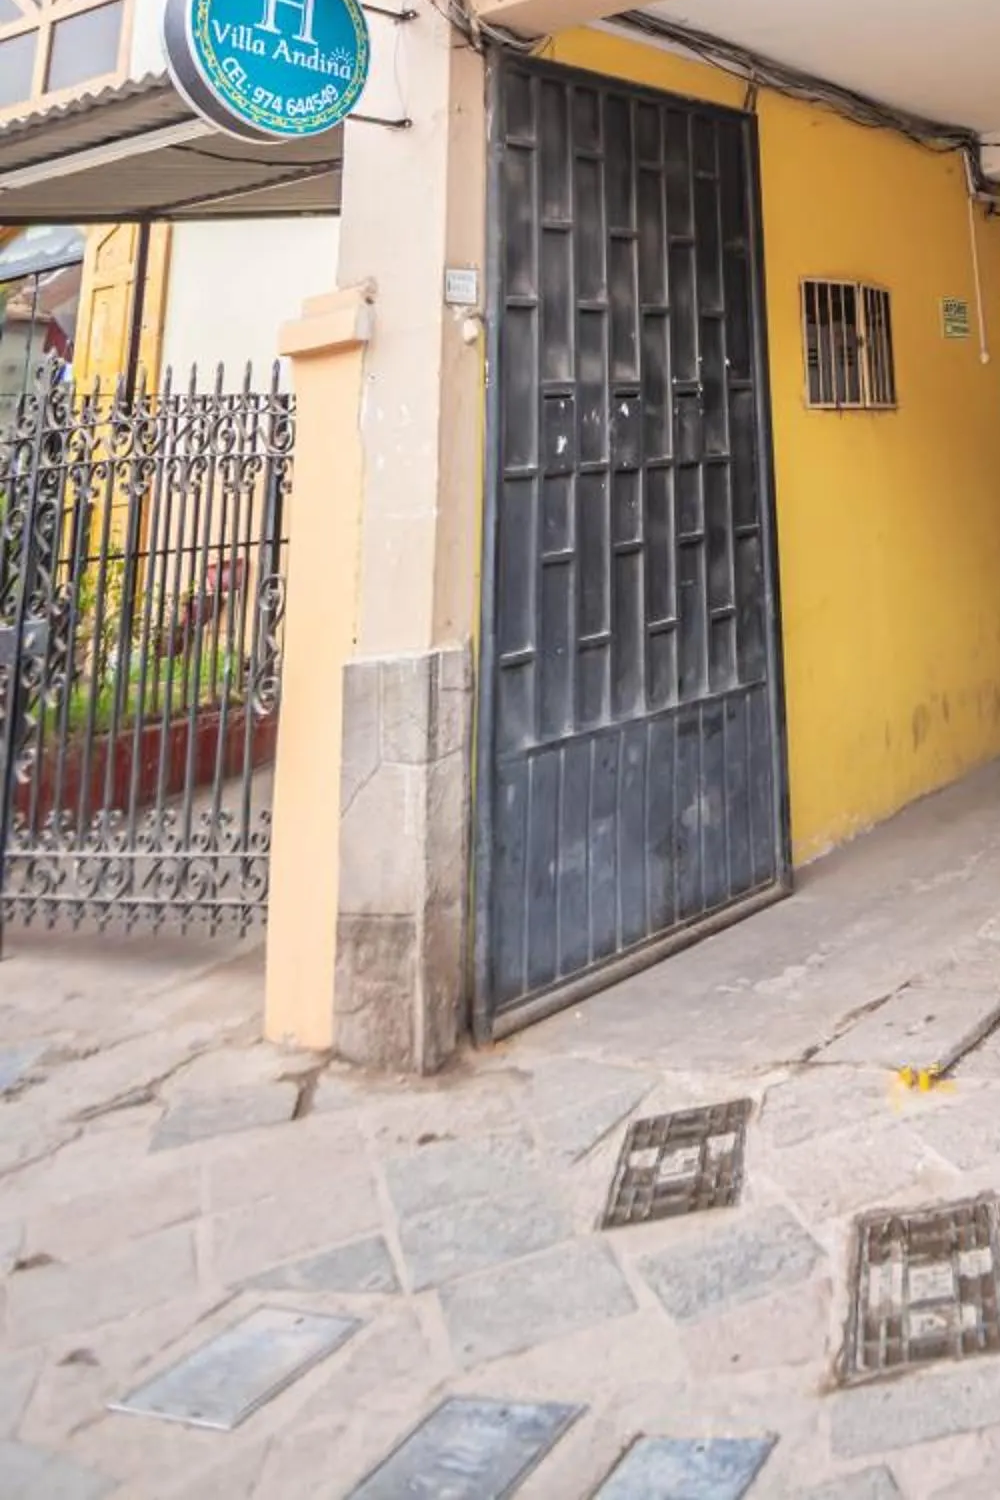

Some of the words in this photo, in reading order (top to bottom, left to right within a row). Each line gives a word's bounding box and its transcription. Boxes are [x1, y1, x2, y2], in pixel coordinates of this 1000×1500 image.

[210, 18, 267, 56] Villa
[271, 38, 352, 81] Andina
[221, 56, 251, 94] CEL:
[251, 86, 284, 114] 974
[285, 83, 340, 117] 644549
